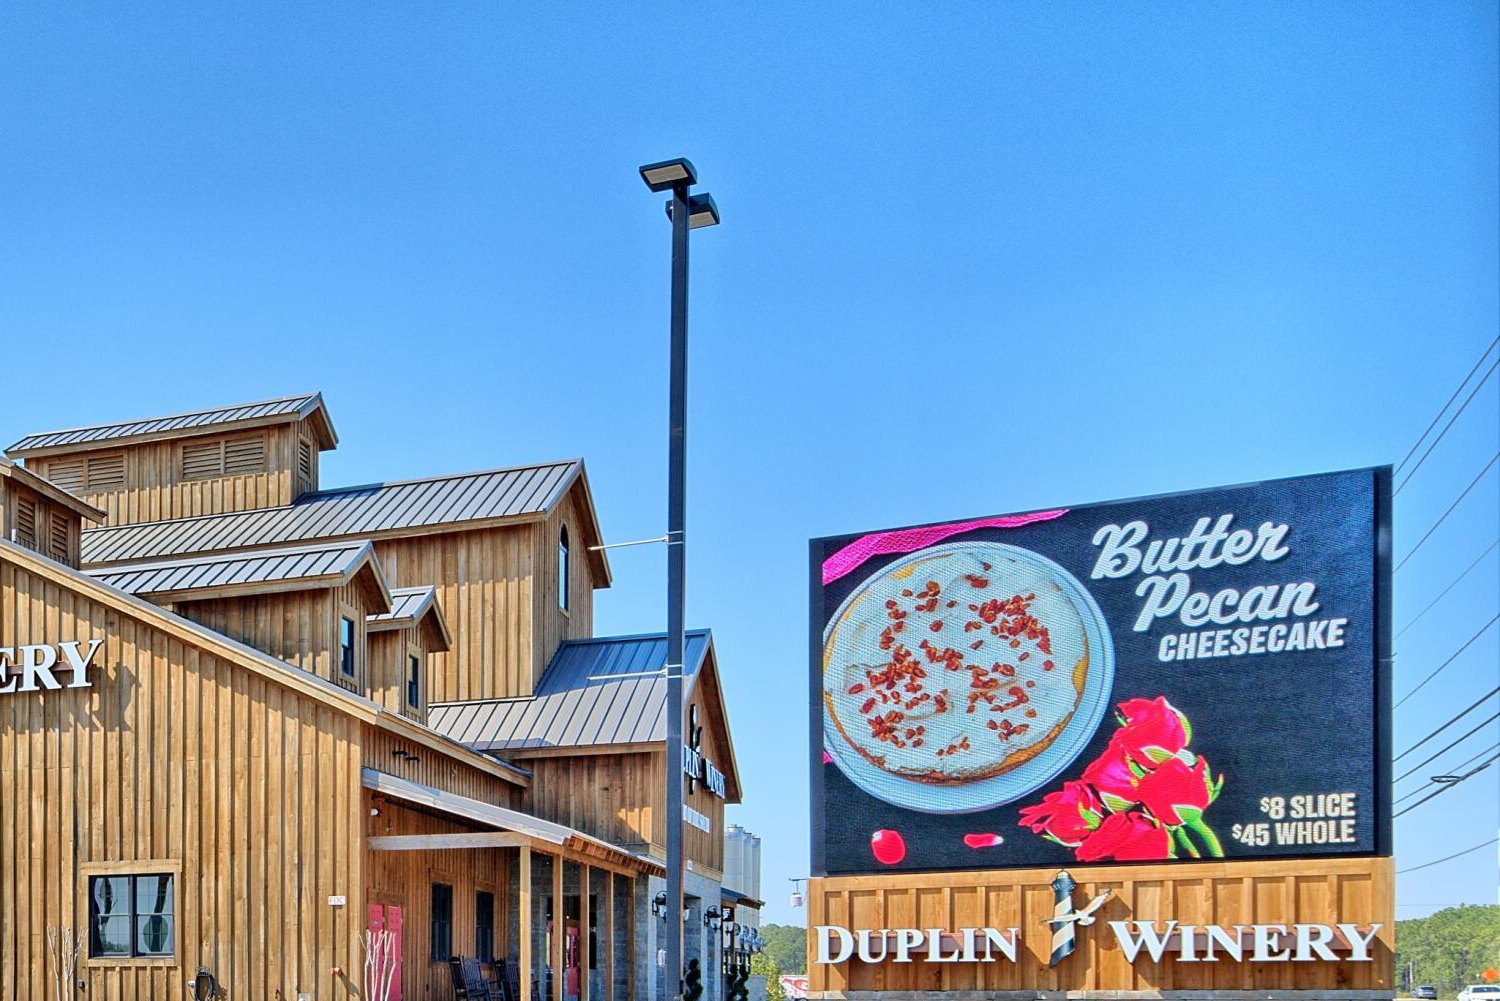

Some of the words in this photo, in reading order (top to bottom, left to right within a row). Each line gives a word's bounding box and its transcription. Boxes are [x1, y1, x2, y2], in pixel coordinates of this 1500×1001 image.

[1090, 513, 1289, 580] Butter
[1132, 572, 1320, 632] Pecan
[1158, 618, 1348, 662] CHEESECAKE
[1259, 796, 1286, 819] $8
[1290, 793, 1356, 819] SLICE
[1231, 822, 1270, 846] $45
[1275, 819, 1356, 845] WHOLE
[813, 925, 1019, 964] DUPLIN
[1108, 920, 1383, 963] WINERY
